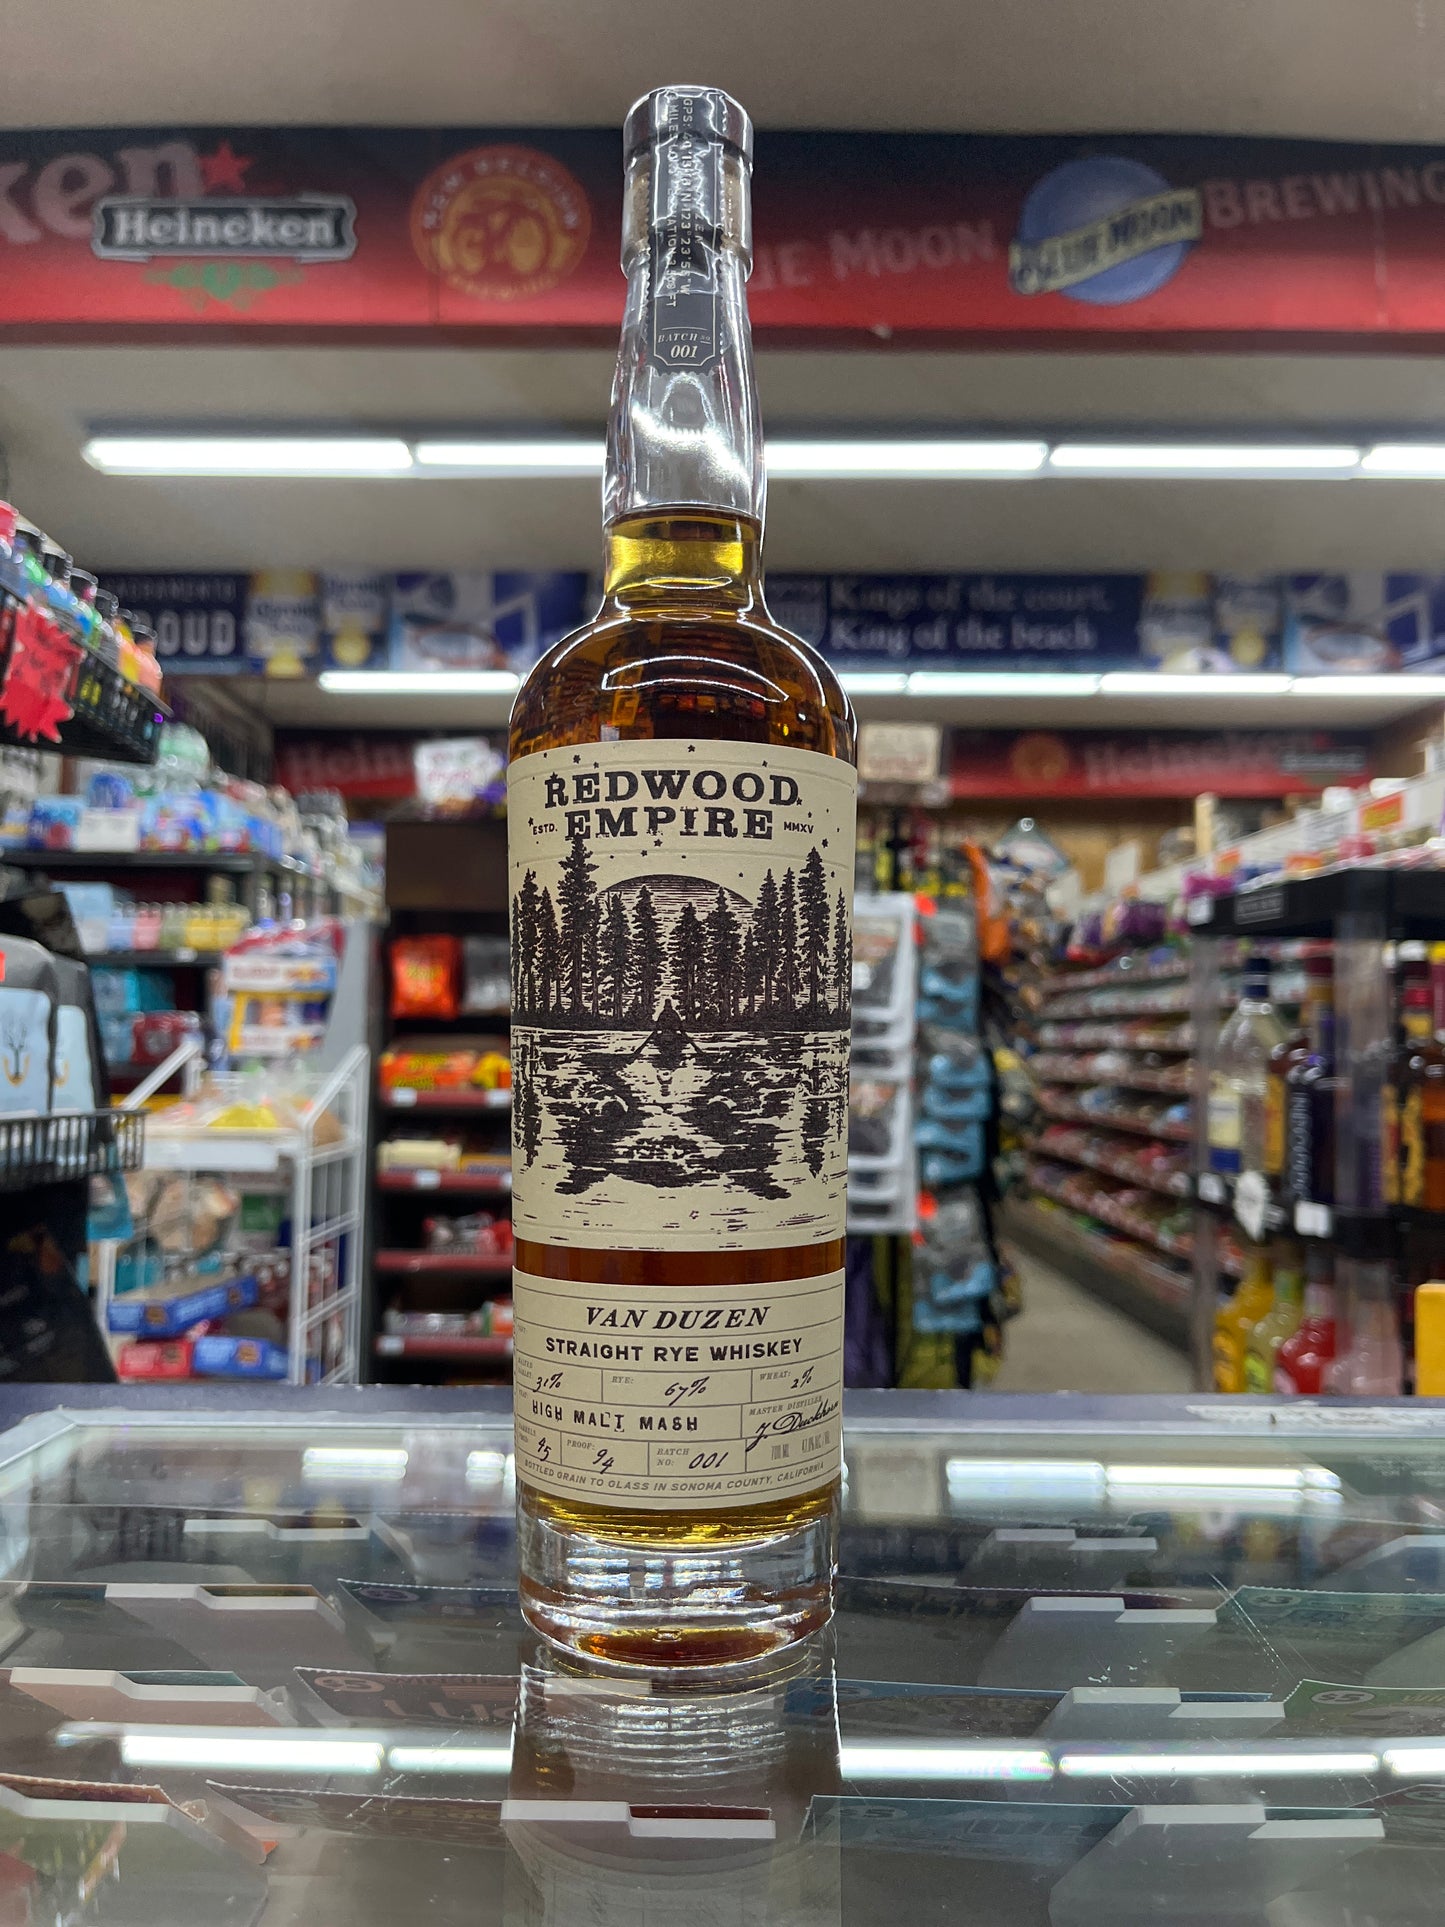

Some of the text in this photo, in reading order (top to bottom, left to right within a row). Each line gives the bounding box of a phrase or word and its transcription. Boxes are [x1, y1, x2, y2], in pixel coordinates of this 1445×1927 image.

[682, 98, 693, 127] GPS:
[112, 208, 337, 247] Heineken
[657, 333, 698, 343] BATCH
[670, 345, 698, 359] 001
[545, 770, 799, 808] REDWOOD
[532, 824, 558, 835] ESTD.
[565, 806, 773, 841] EMPIRE
[783, 821, 814, 834] MMXV
[587, 1306, 771, 1330] VAN DUZEN
[546, 1337, 803, 1362] STRAIGHT RYE WHISKEY
[612, 1376, 634, 1384] RYE:
[759, 1371, 792, 1381] WHEAT:
[790, 1365, 815, 1390] 2%
[664, 1376, 710, 1406] 67%
[532, 1400, 698, 1431] HIGH MALT MASH
[749, 1405, 783, 1416] MASTER
[567, 1439, 595, 1450] PROOF:
[656, 1448, 689, 1456] BATCH
[592, 1448, 615, 1474] 94
[688, 1452, 729, 1470] 001
[524, 1459, 824, 1492] BOTTLED GRAIN TO GLASS IN SONOMA COUNTY, CALIFORNIA
